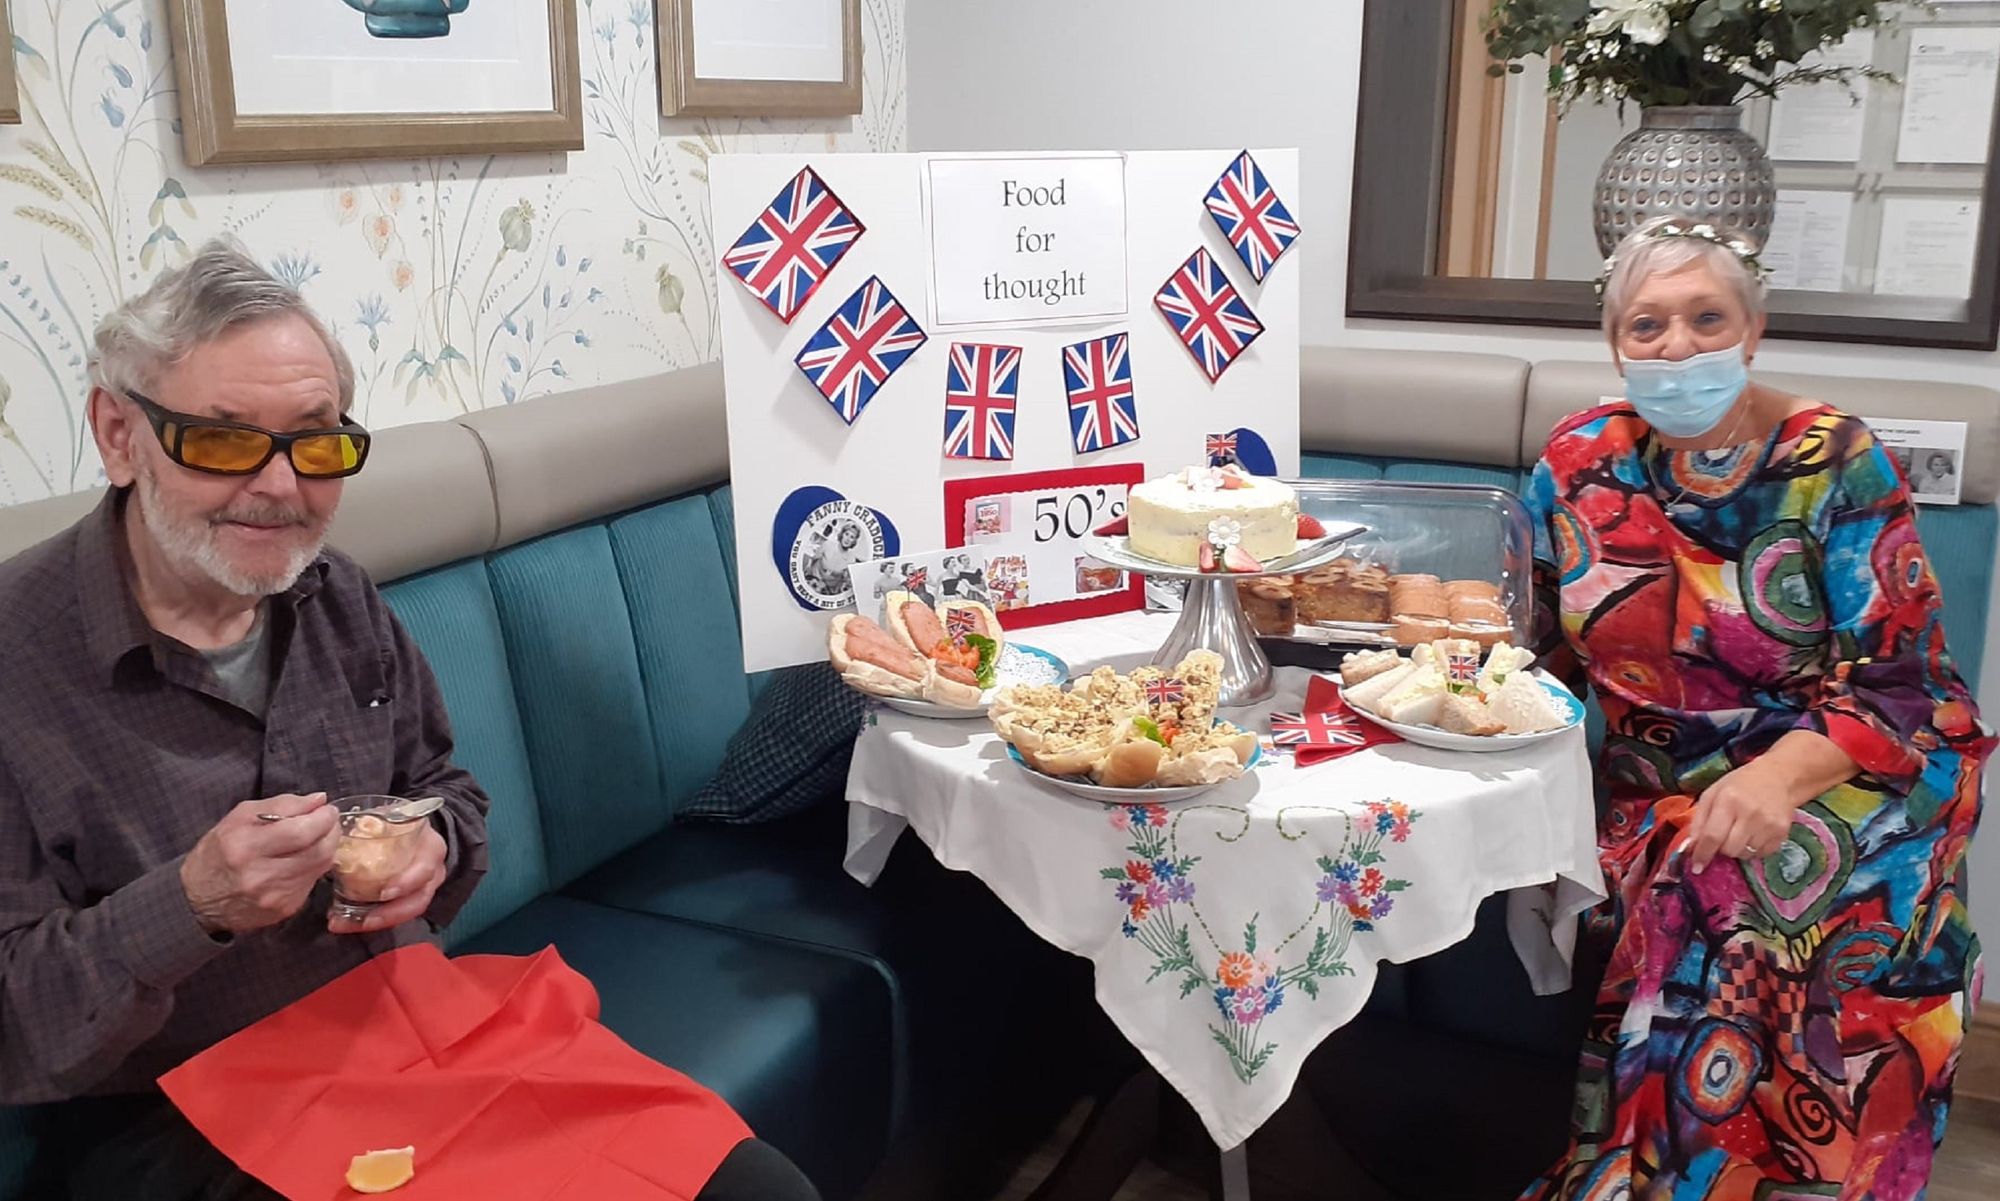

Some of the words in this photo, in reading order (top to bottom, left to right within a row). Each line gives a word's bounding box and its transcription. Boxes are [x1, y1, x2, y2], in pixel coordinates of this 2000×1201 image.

[1002, 178, 1066, 207] Food
[1015, 225, 1056, 253] for
[983, 269, 1086, 306] thought
[805, 501, 851, 528] FANNY
[853, 505, 884, 560] CRADOCK
[1034, 488, 1125, 543] 50's
[792, 540, 802, 559] YOU
